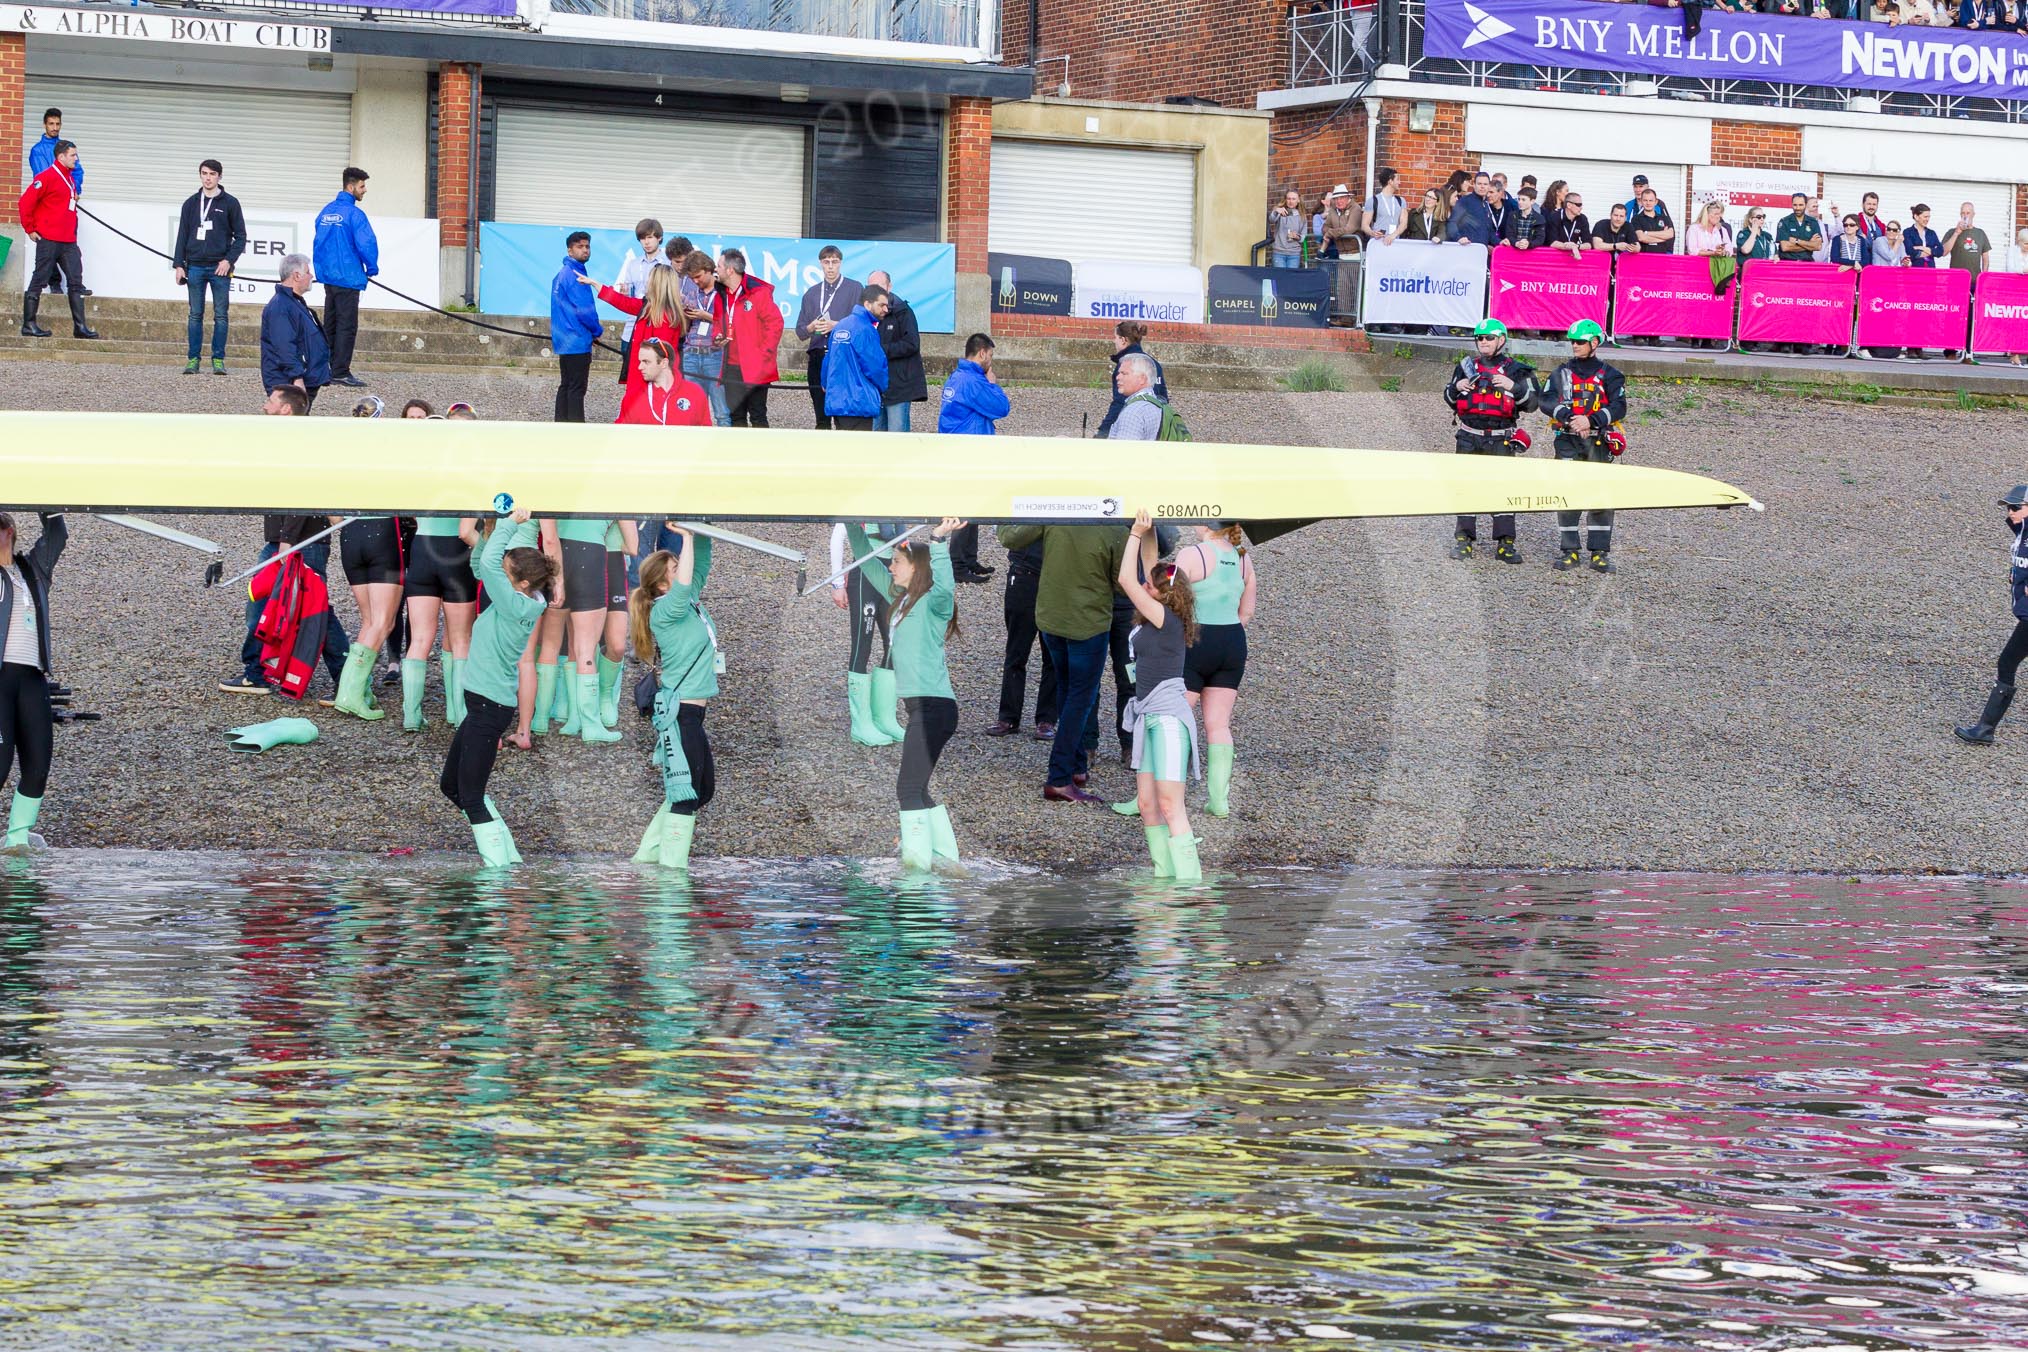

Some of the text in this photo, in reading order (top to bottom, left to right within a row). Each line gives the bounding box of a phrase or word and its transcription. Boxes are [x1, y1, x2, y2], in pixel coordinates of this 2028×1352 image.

[19, 8, 328, 50] & ALPHA BOAT CLUB
[1534, 15, 1786, 66] BNY MELLON
[655, 94, 663, 105] 4
[1379, 276, 1471, 297] smartwater
[1520, 280, 1598, 296] BNY MELLON
[1023, 291, 1058, 303] DOWN
[1643, 290, 1673, 299] CANCER
[1675, 291, 1712, 301] RESEARCH
[1214, 299, 1318, 312] CHAPEL DOWN
[1765, 296, 1844, 309] CANCER RESEARCH UK
[1884, 301, 1960, 313] CANCER RESEARCH UK
[1090, 300, 1188, 321] smartwater
[1025, 502, 1066, 511] RESEARCH
[1066, 502, 1099, 511] CANCER
[1506, 495, 1568, 509] Venit Lux
[1157, 504, 1222, 517] CUW805
